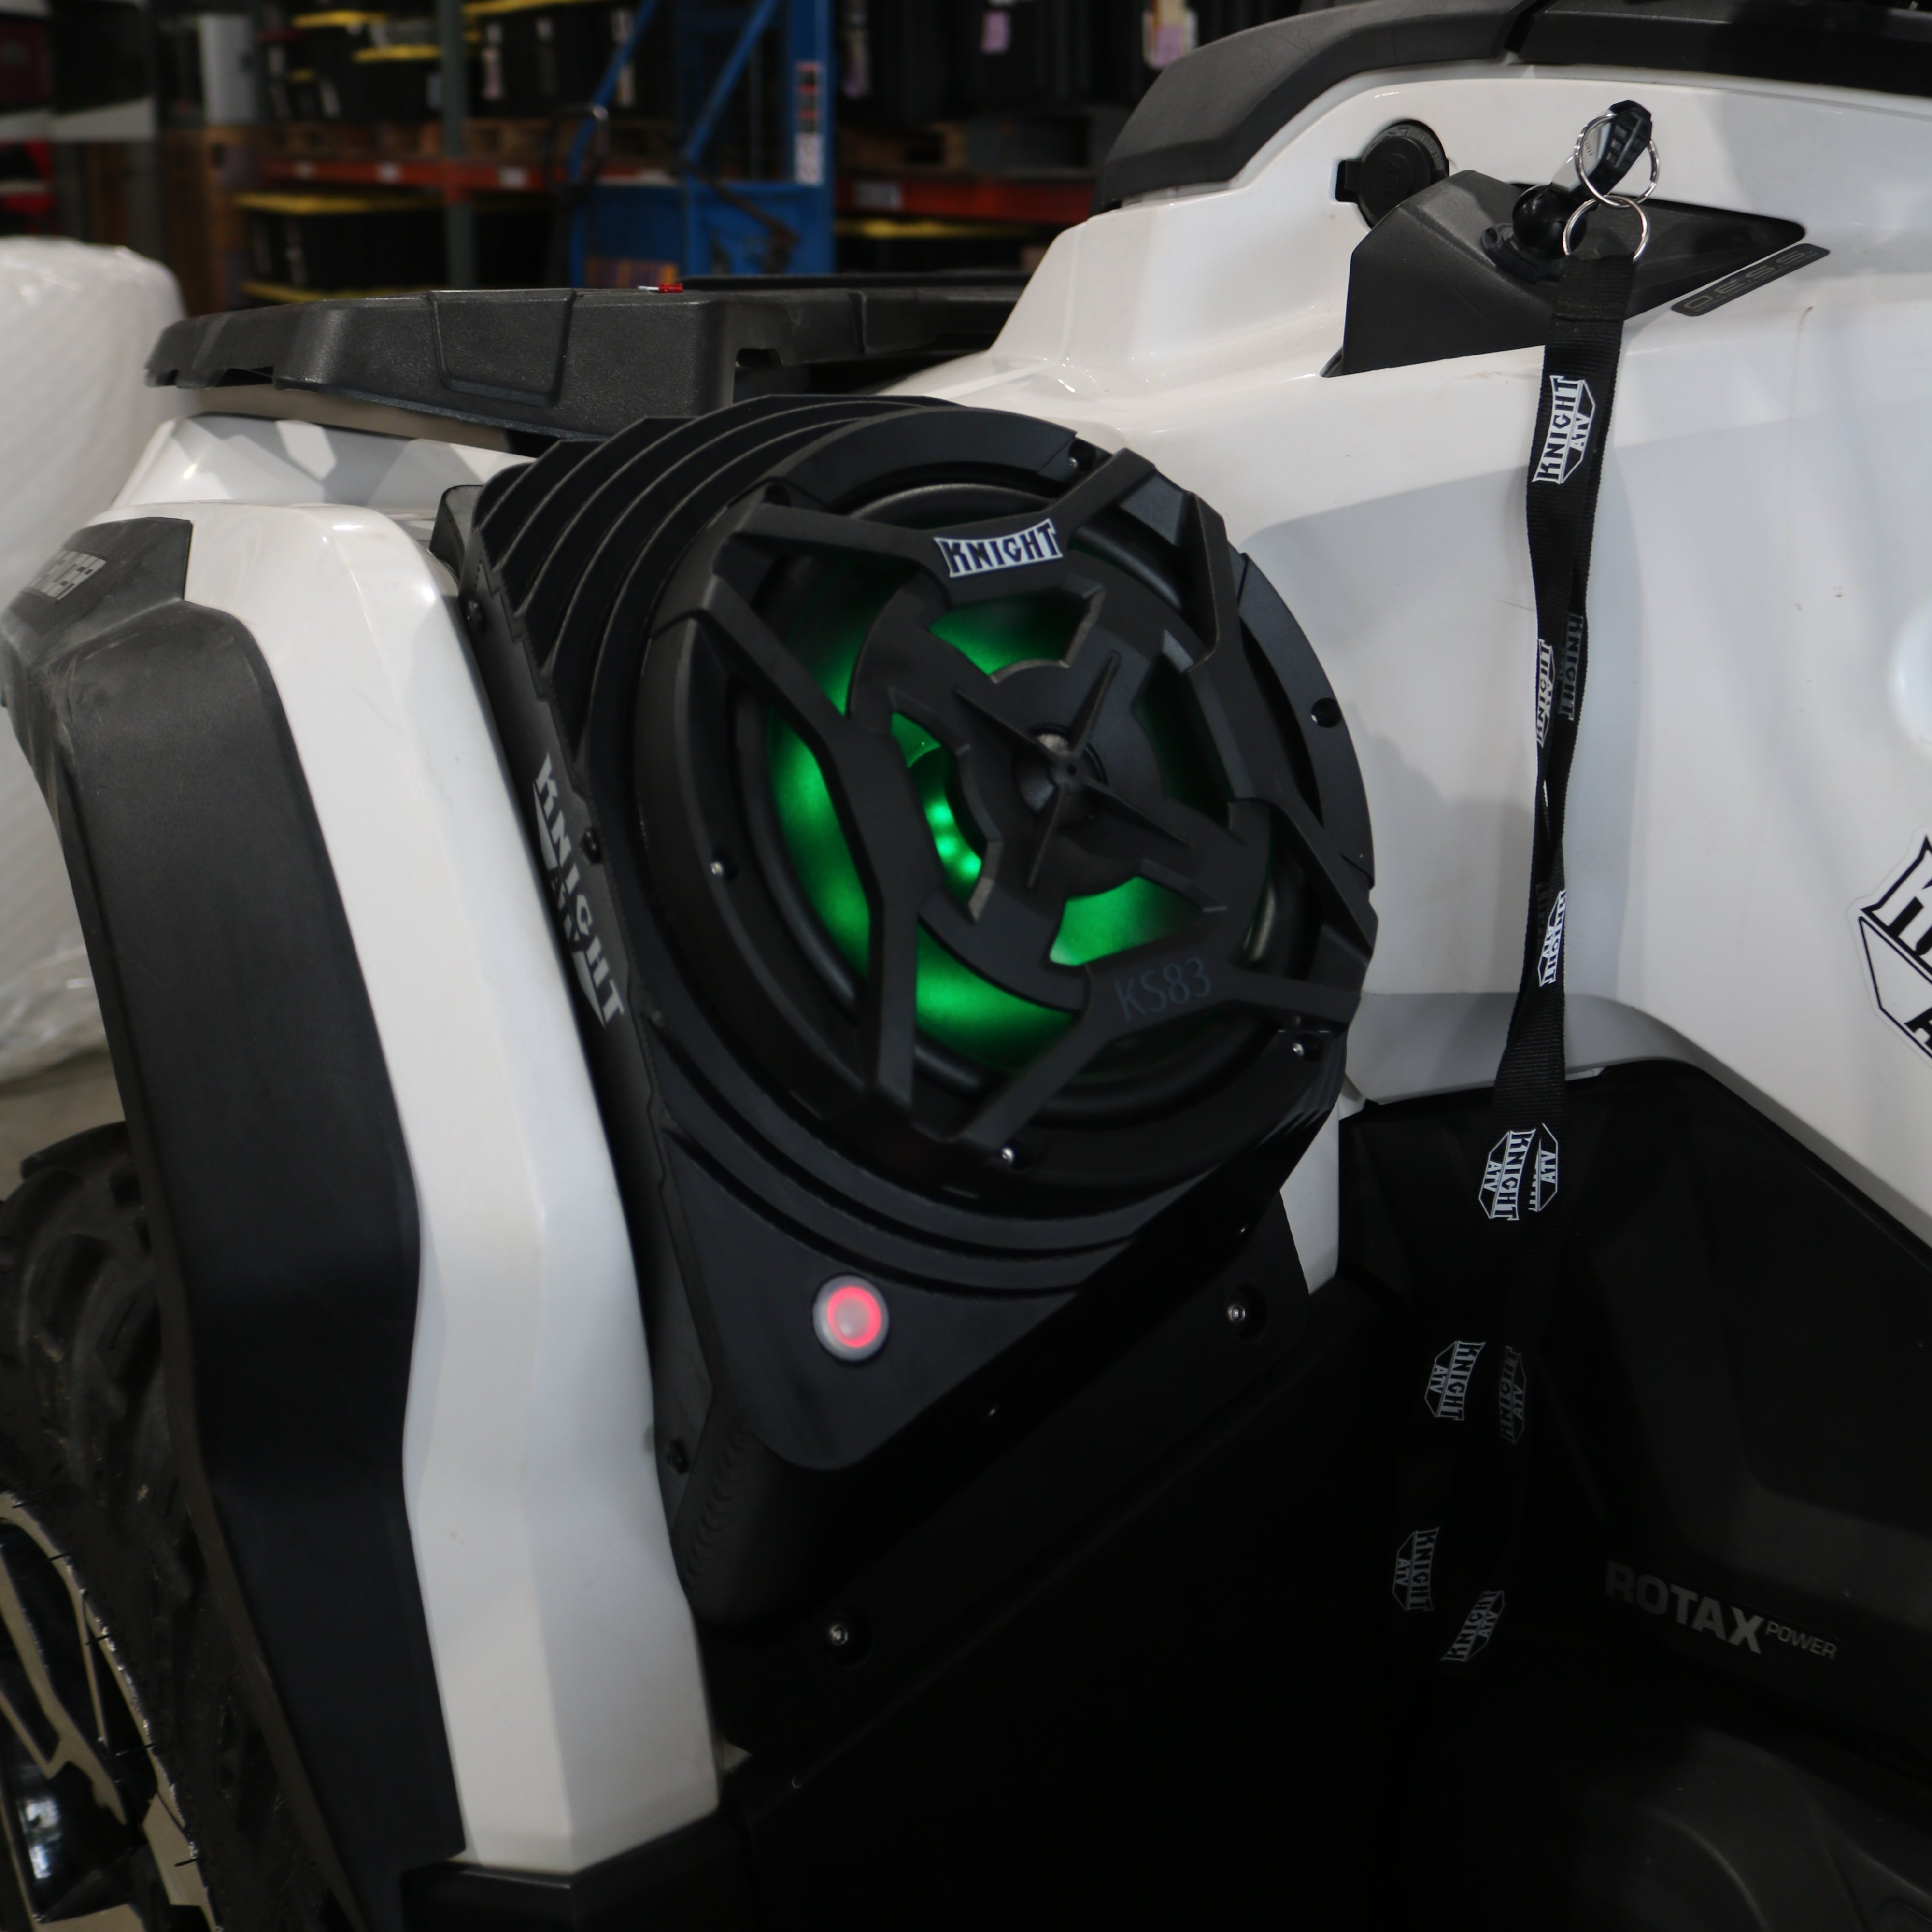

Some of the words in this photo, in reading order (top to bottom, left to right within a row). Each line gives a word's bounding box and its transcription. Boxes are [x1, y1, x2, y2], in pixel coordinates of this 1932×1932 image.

[1534, 376, 1580, 482] KNIGHT
[1569, 412, 1591, 452] ATV
[937, 519, 1061, 575] KNIGHT
[1560, 614, 1583, 719] KNIGHT
[535, 752, 625, 1023] KNIGHT
[1114, 957, 1211, 1022] KS83
[1483, 1161, 1503, 1192] ATV
[1493, 1132, 1534, 1220] KNIGHT
[1540, 1150, 1556, 1184] ATV
[1429, 1364, 1449, 1394] ATV
[1438, 1342, 1484, 1420] KNIGHT
[1499, 1346, 1519, 1441] KNIGHT
[1512, 1383, 1524, 1421] ATV
[1395, 1558, 1411, 1587] ATV
[1408, 1529, 1438, 1610] KNIGHT
[1443, 1591, 1501, 1660] KNIGHT
[1478, 1611, 1498, 1639] ATV
[1605, 1559, 1765, 1655] ROTAX
[1765, 1620, 1837, 1661] POWER
